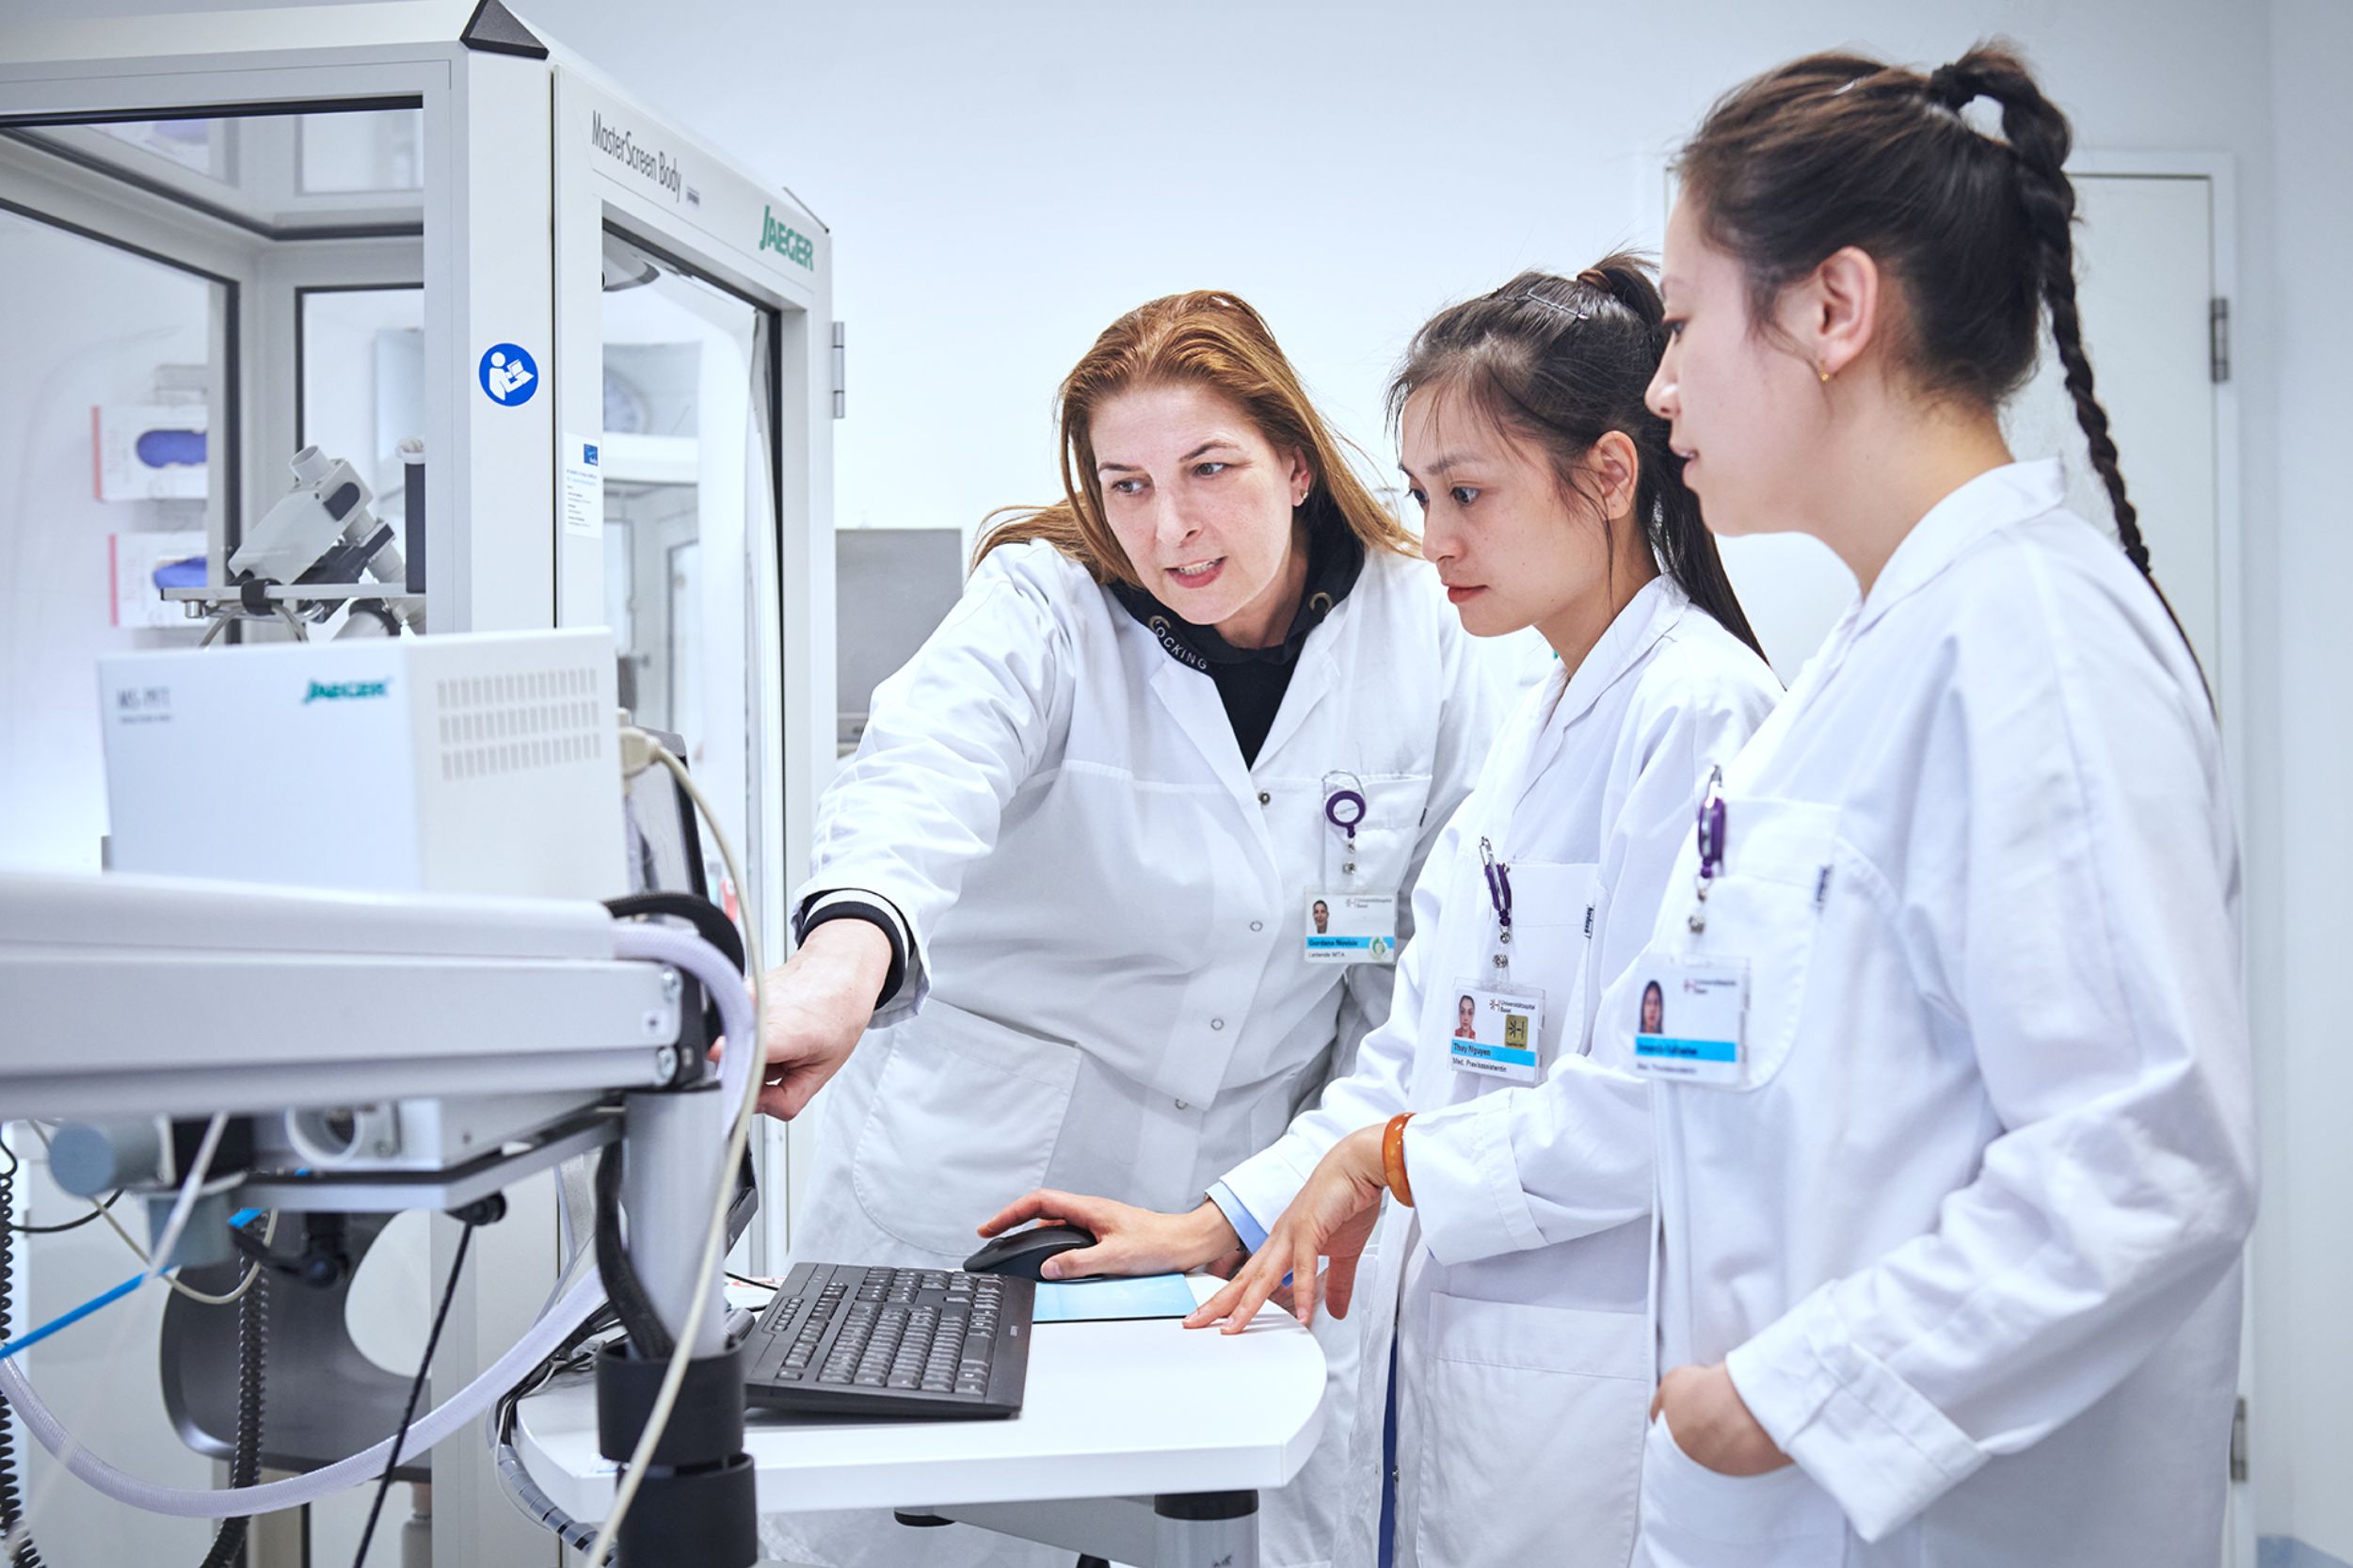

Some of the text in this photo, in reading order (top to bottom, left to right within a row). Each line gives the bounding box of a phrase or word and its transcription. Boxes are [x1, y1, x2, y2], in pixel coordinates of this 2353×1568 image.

[592, 109, 682, 203] MasterScreen Body
[759, 204, 815, 272] JAEGER
[1155, 621, 1208, 670] OCKING
